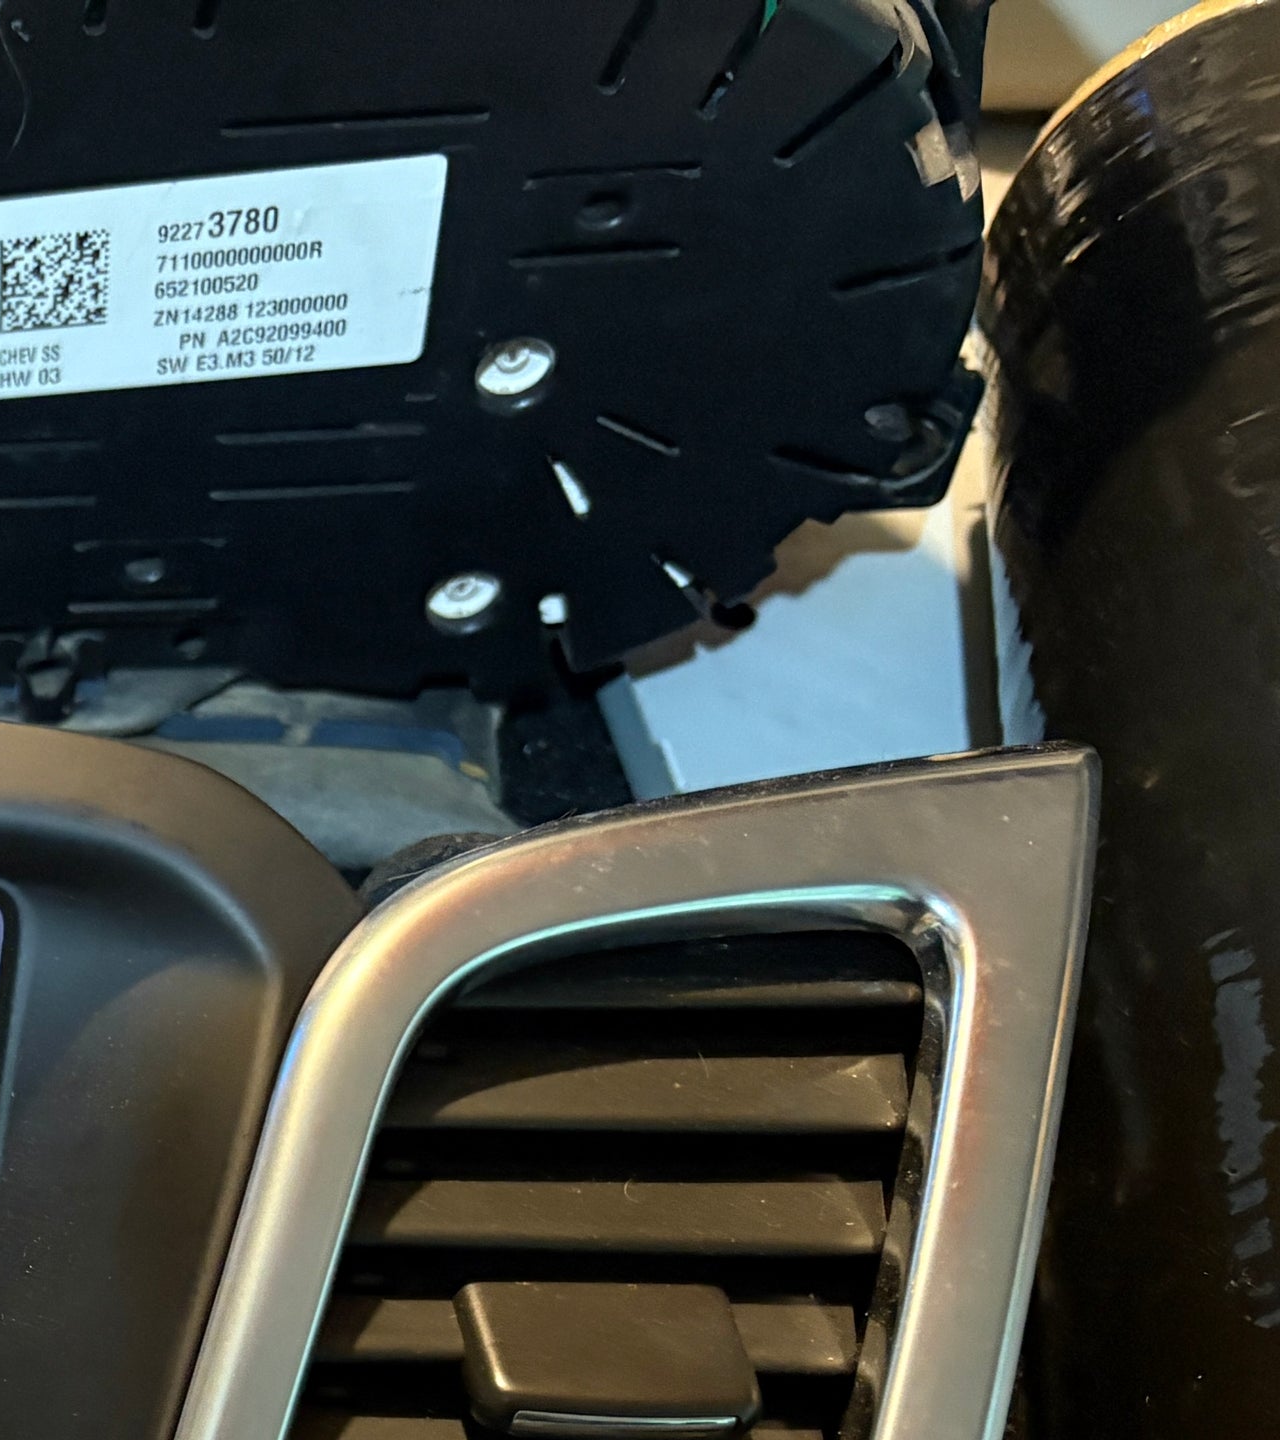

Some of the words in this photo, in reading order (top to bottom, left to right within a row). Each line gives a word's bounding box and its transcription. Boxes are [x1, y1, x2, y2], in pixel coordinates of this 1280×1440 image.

[153, 272, 259, 300] 652100520
[153, 303, 239, 327] ZN14288
[246, 292, 349, 319] 123000000
[40, 339, 62, 363] SS
[178, 332, 207, 351] PN
[156, 356, 188, 376] SW
[261, 343, 317, 367] 50/12
[0, 369, 33, 389] HW
[37, 366, 62, 386] 03
